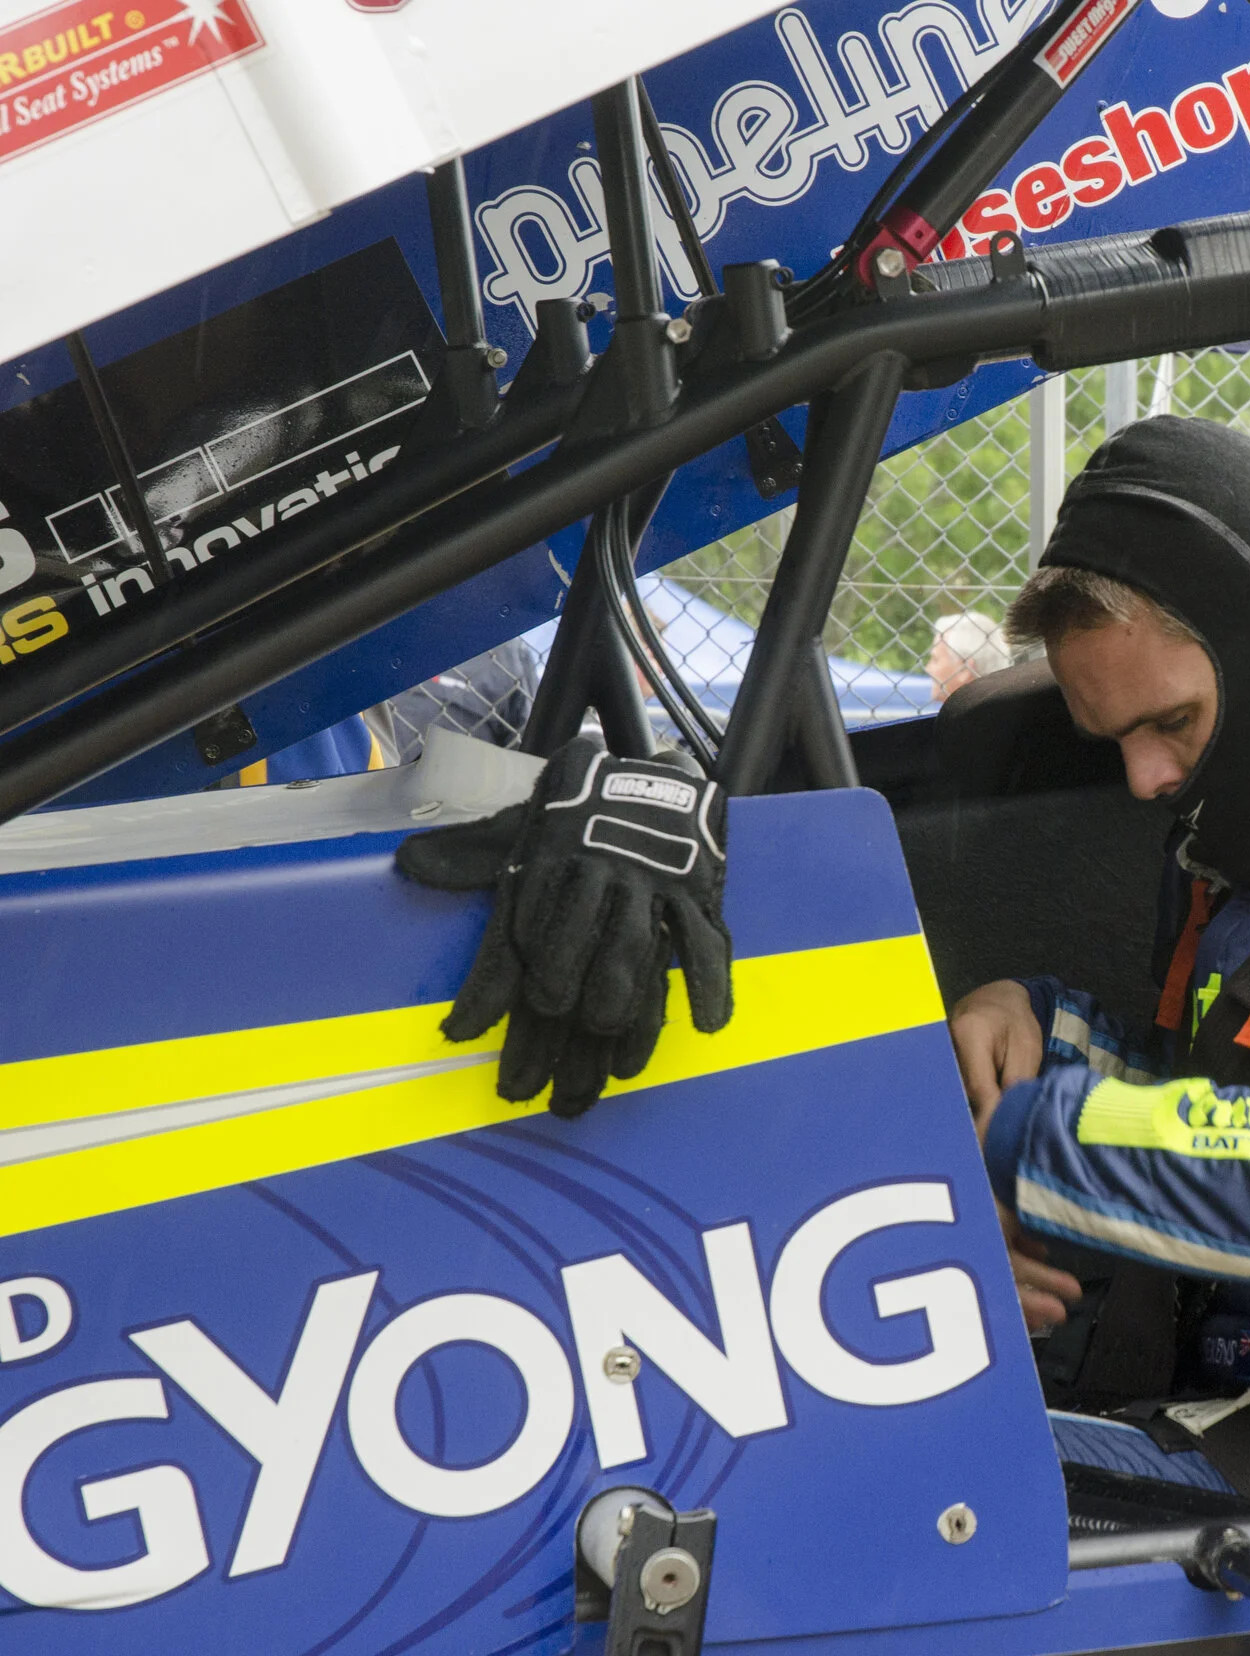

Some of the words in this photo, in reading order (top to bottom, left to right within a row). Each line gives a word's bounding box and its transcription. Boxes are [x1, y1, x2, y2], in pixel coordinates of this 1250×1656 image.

[13, 84, 67, 126] Seat
[70, 46, 164, 107] Systems
[0, 1182, 991, 1610] GYONG
